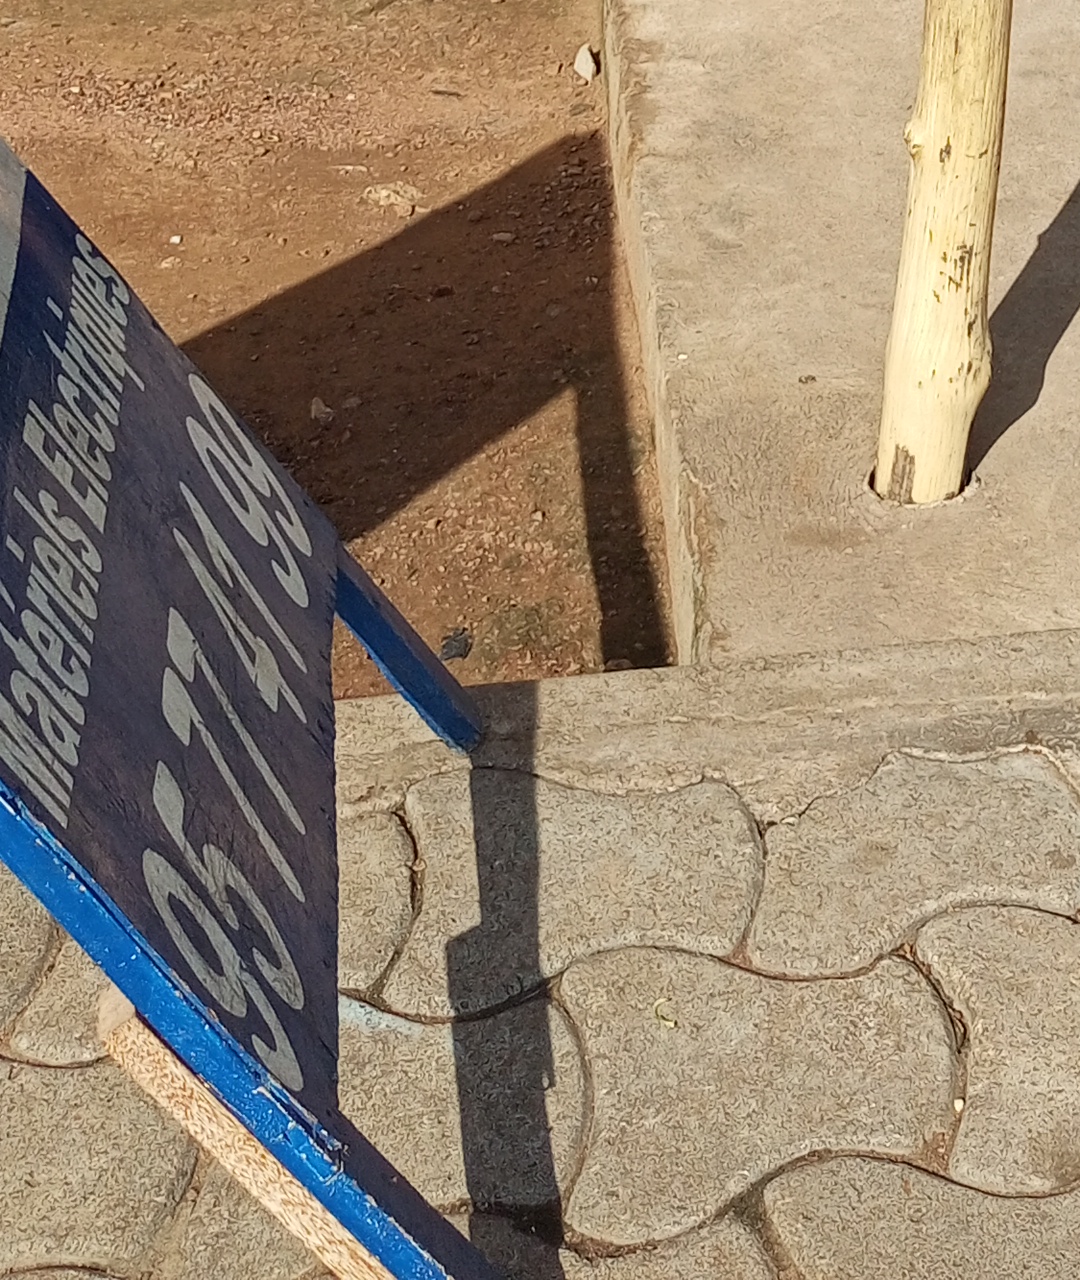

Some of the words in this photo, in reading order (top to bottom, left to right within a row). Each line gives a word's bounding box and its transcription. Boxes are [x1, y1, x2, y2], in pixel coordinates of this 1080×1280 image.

[23, 233, 145, 535] Electriques
[185, 372, 312, 609] 99
[0, 486, 104, 830] Matériels
[172, 480, 307, 725] 41
[162, 606, 305, 903] 77
[142, 759, 304, 1093] 95
